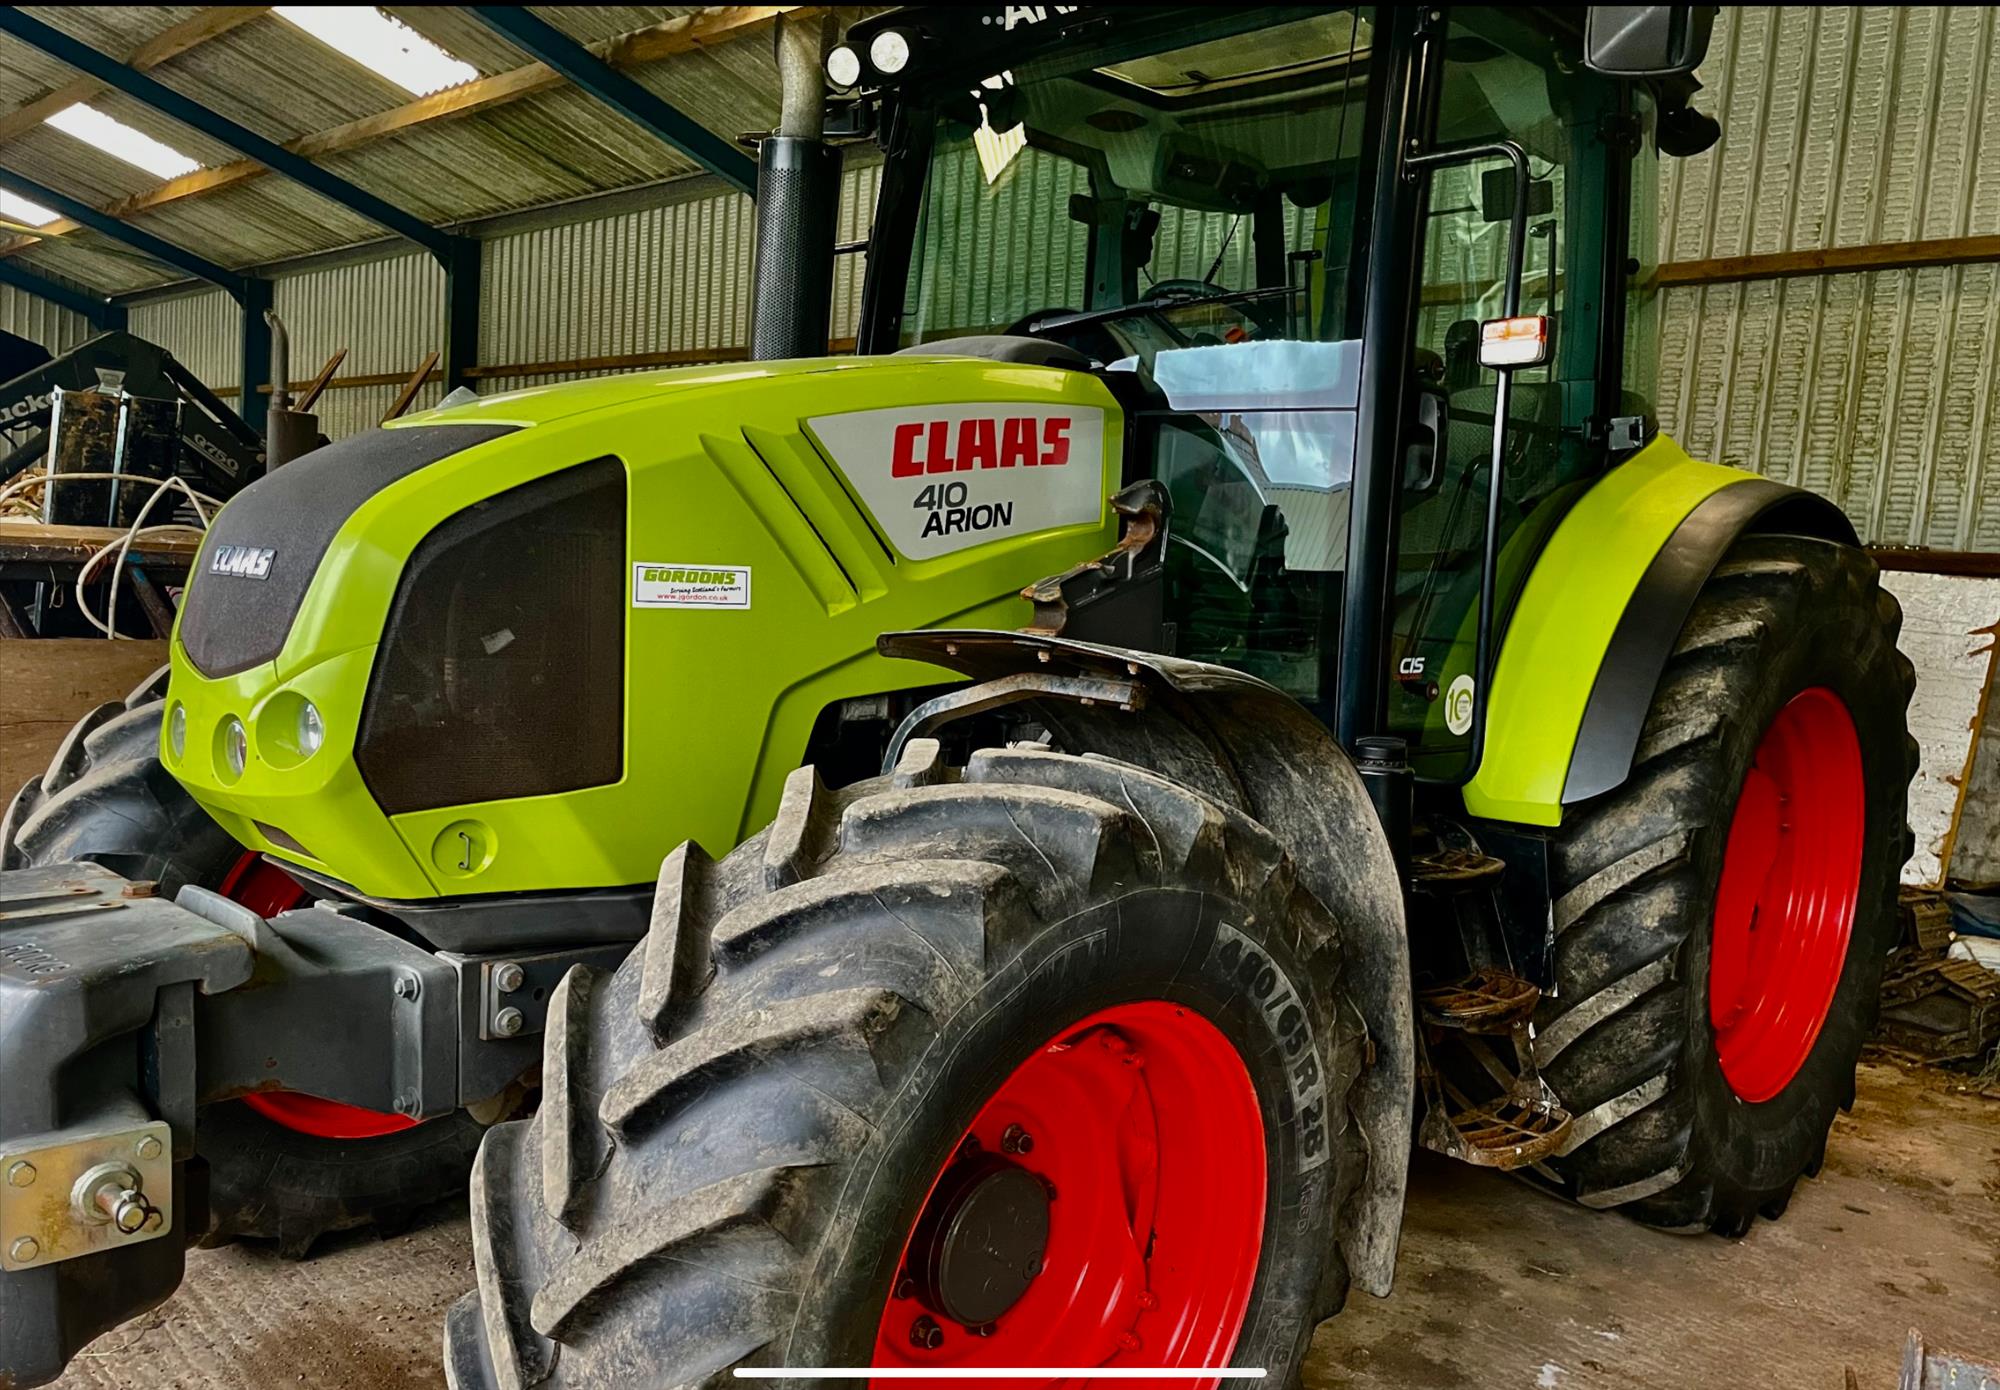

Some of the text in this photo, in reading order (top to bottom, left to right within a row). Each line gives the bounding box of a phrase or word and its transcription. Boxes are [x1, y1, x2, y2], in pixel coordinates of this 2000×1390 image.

[194, 434, 239, 471] Q750
[892, 418, 1071, 478] CLAAS
[913, 482, 968, 511] 410
[921, 502, 1013, 538] ARION
[643, 569, 736, 585] GORDONS
[657, 593, 728, 601] www.jgordon.co.uk
[1400, 657, 1425, 674] CIS
